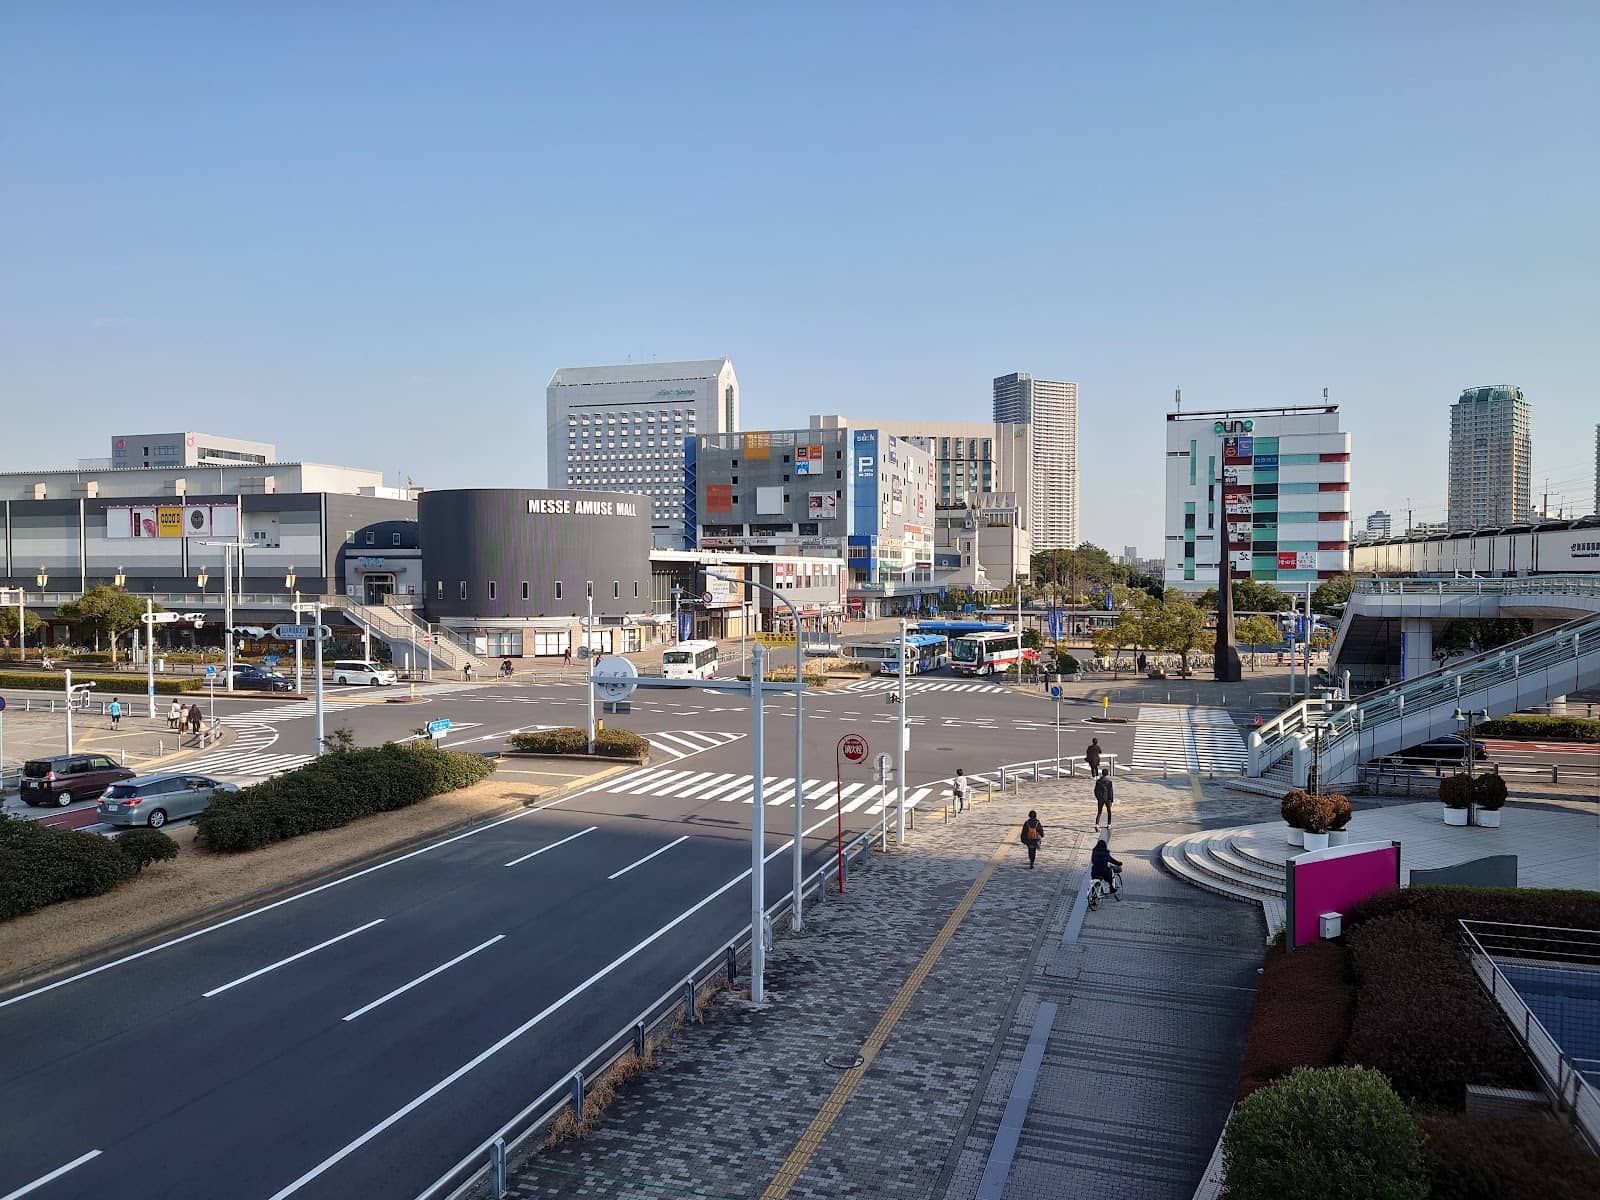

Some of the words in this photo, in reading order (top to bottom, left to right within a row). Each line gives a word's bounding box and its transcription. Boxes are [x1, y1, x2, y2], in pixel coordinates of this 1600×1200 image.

[527, 499, 570, 515] MESSE
[574, 500, 613, 516] AMUSE
[615, 502, 637, 517] MALL
